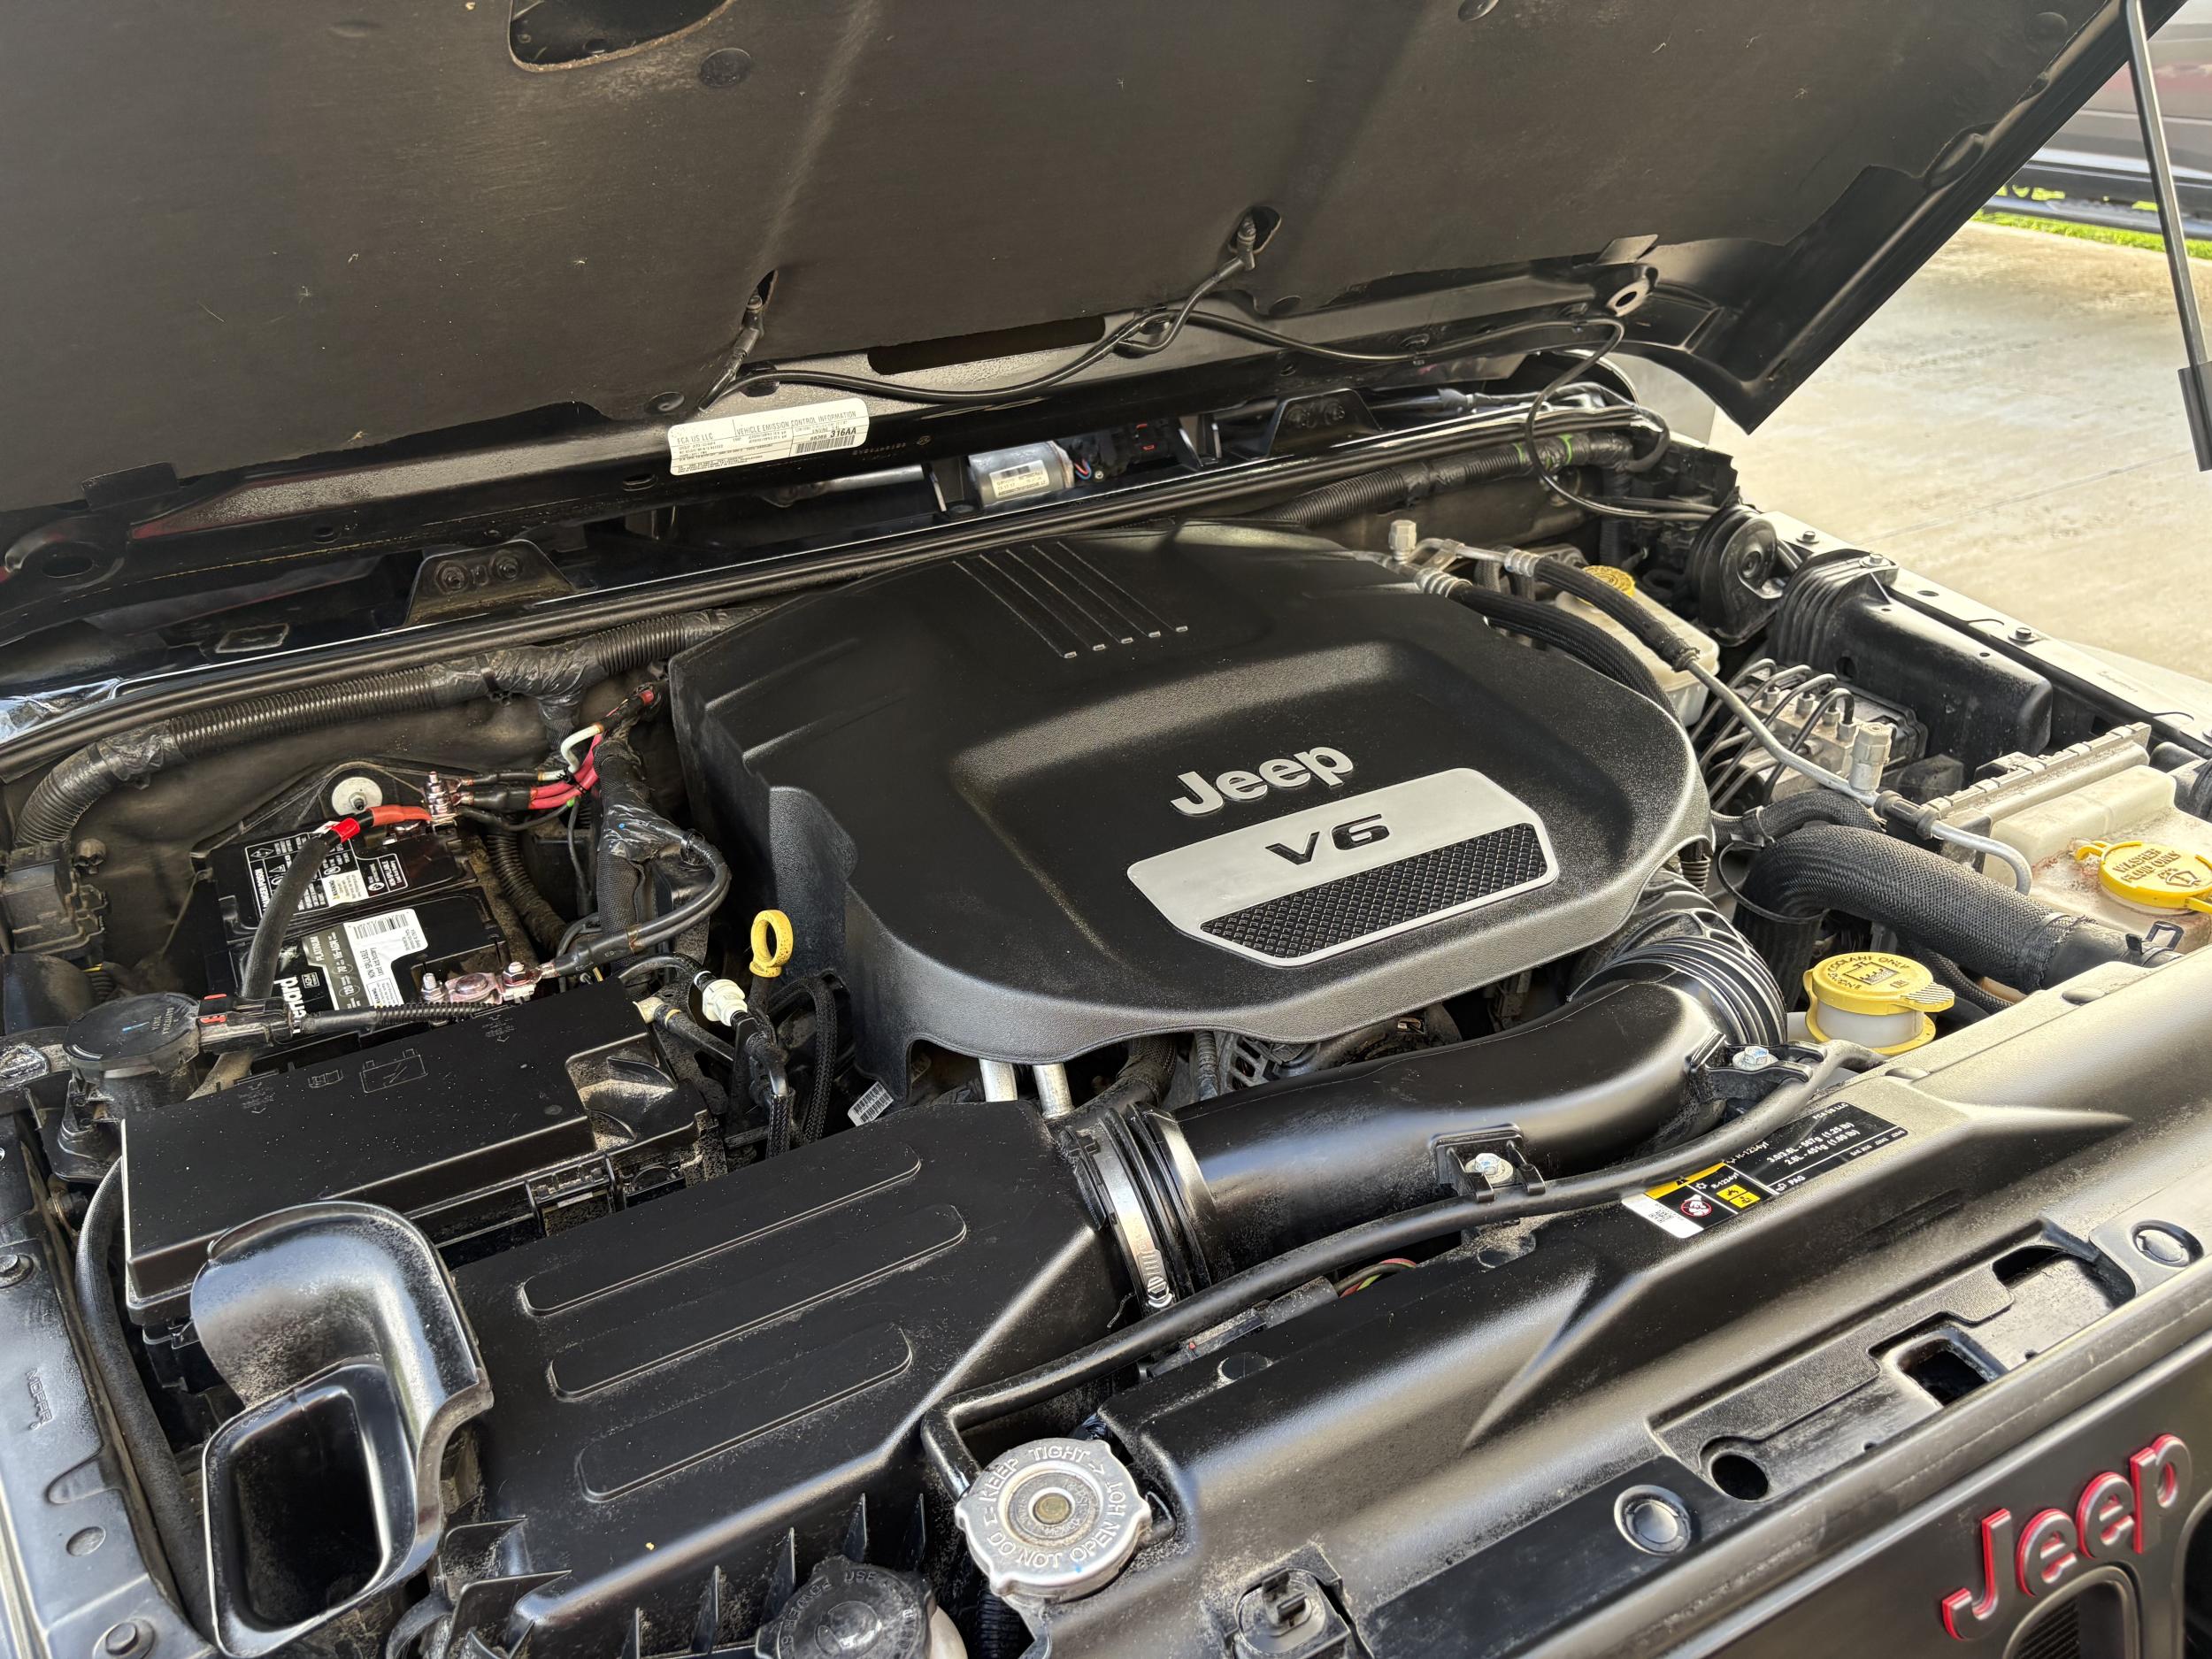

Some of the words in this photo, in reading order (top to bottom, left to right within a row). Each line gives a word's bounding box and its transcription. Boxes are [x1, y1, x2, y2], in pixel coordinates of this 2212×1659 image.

[677, 436, 689, 445] FCA
[736, 425, 761, 435] VEHICLE
[762, 420, 789, 432] EMISSION
[790, 417, 817, 427] CONTROL
[818, 411, 856, 423] INFORMATION
[830, 426, 856, 438] 316AA
[1171, 746, 1355, 816] Jeep
[1263, 813, 1392, 866] V6
[979, 1457, 1019, 1502] KEEP
[1028, 1446, 1091, 1461] TIGHT
[987, 1531, 1017, 1555] DO
[1016, 1550, 1063, 1568] NOT
[1069, 1520, 1120, 1563] OPEN
[1105, 1481, 1126, 1517] HOT
[1942, 1433, 2193, 1642] Jeep
